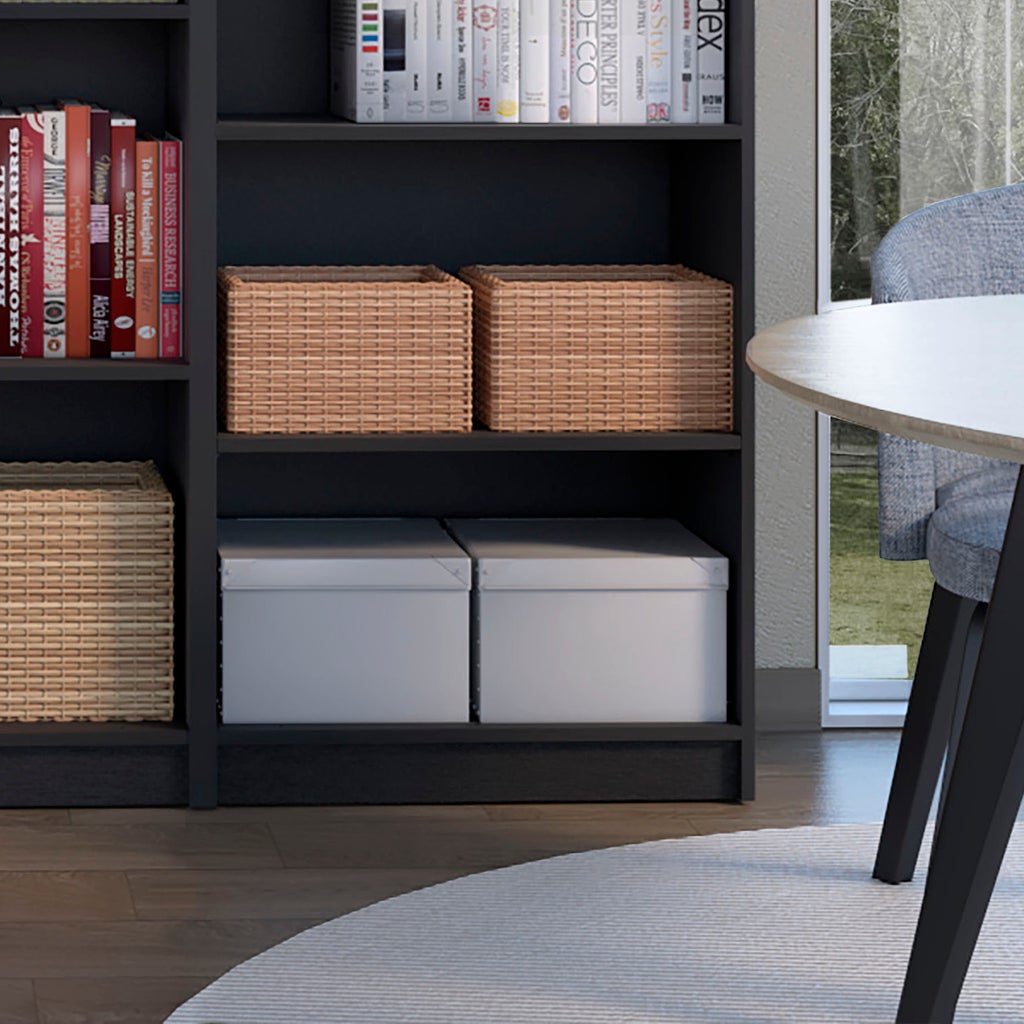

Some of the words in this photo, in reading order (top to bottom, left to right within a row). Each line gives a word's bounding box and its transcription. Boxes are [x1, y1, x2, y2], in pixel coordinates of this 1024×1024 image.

[9, 127, 19, 233] HARRIS
[142, 157, 154, 170] To
[142, 171, 154, 188] Kill
[125, 191, 134, 256] SUSTAINABLE
[139, 197, 154, 255] Mockingbird
[164, 172, 176, 226] BUSINESS
[114, 214, 123, 279] LANDSCAPES
[164, 227, 176, 288] RESEARCH
[9, 236, 19, 346] THOMAS
[125, 259, 134, 298] ENERGY
[90, 319, 108, 341] Airey
